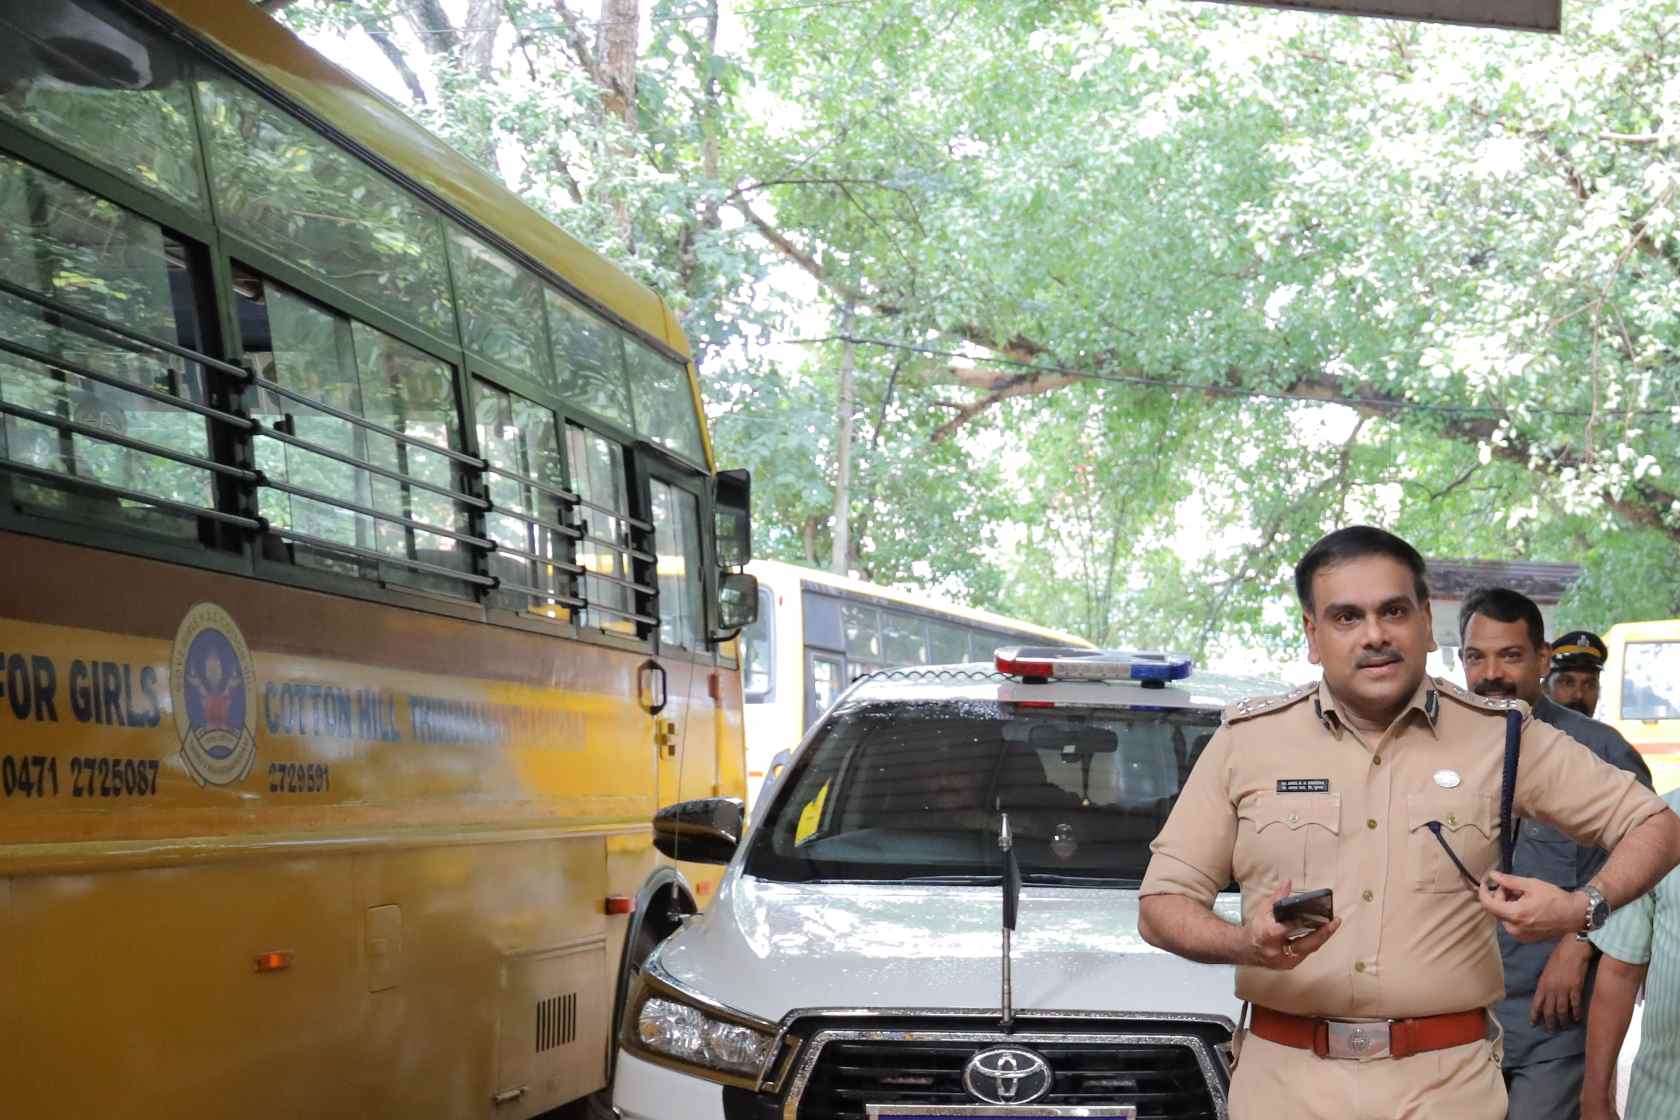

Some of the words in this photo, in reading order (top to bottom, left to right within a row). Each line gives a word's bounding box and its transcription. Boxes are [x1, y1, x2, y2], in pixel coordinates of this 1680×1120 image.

[0, 651, 58, 722] OR
[70, 660, 160, 727] GIRLS
[264, 680, 352, 739] COTTON
[2, 754, 58, 798] 0471
[71, 756, 160, 797] 2725087
